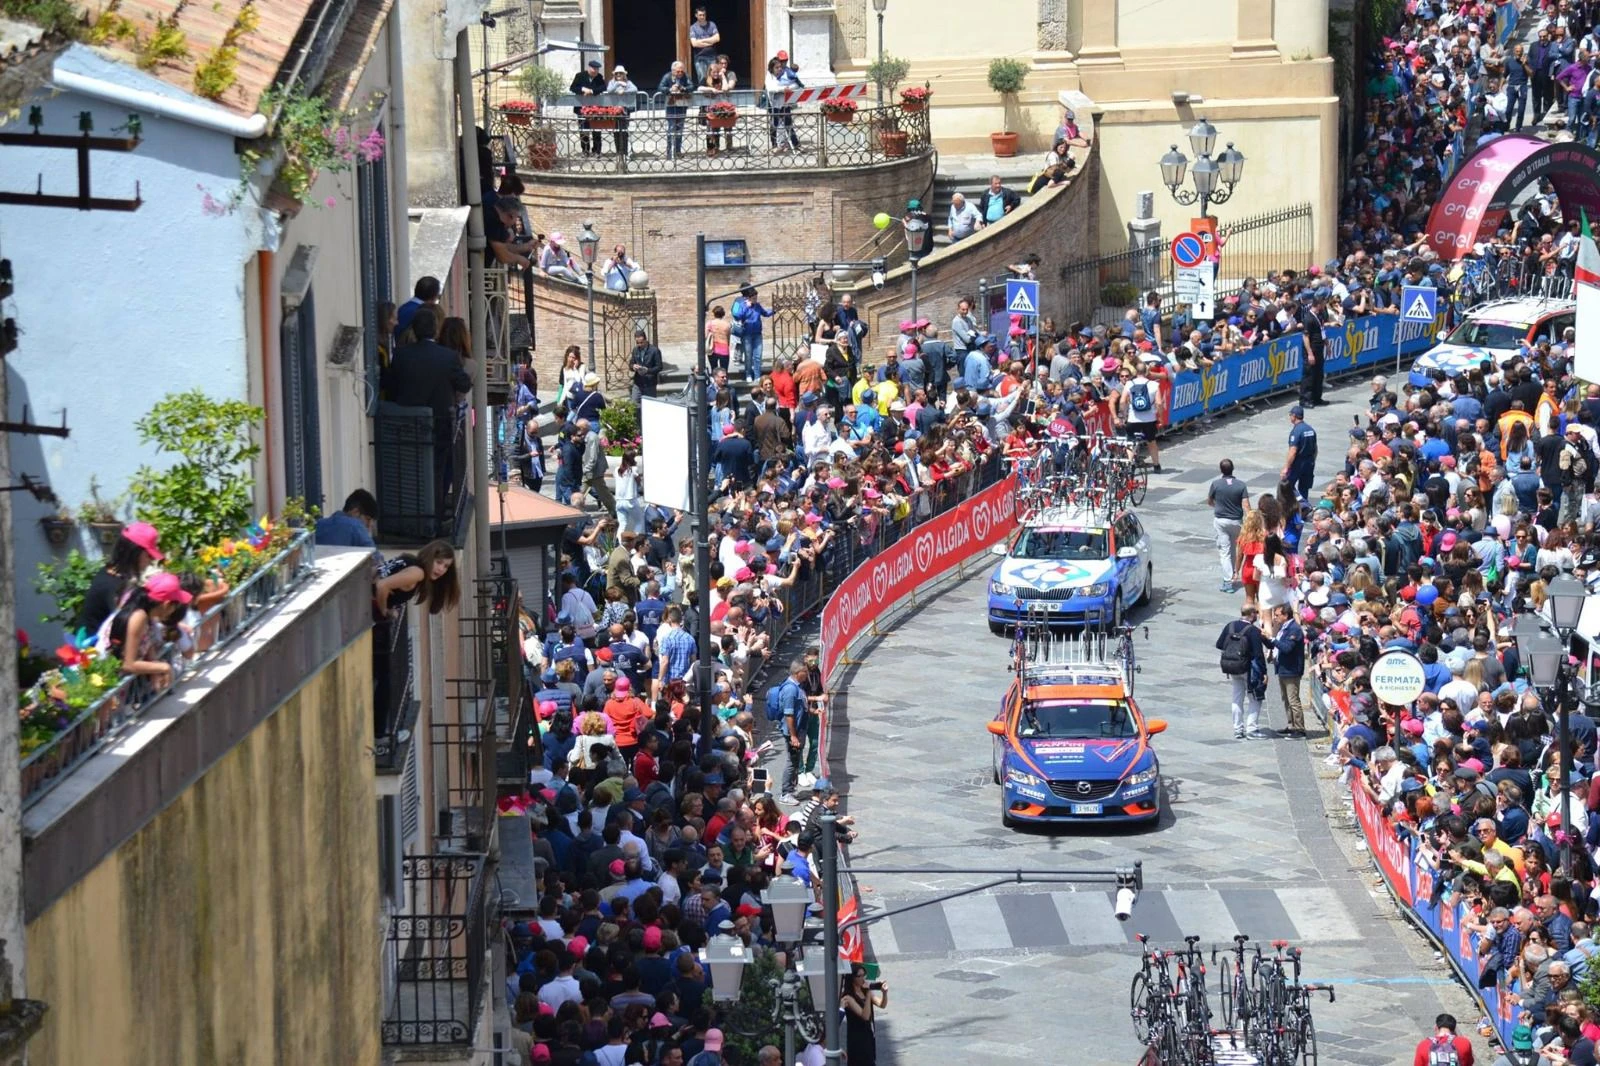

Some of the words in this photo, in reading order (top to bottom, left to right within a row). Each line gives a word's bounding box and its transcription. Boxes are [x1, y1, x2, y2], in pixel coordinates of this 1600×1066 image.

[1458, 178, 1497, 195] enel
[1511, 171, 1527, 188] GIRO
[1527, 155, 1550, 175] D'ITALIA
[1444, 203, 1483, 221] enel
[1435, 231, 1473, 249] enel
[1343, 321, 1379, 364] Spin
[1238, 357, 1265, 387] EURO
[1266, 341, 1299, 385] Spin
[1173, 381, 1199, 410] EURO
[1199, 363, 1229, 409] Spin
[935, 520, 970, 558] ALGIDA
[887, 550, 914, 590] ALGIDA
[851, 578, 872, 618] ALGIDA
[1375, 675, 1421, 684] FERMATA
